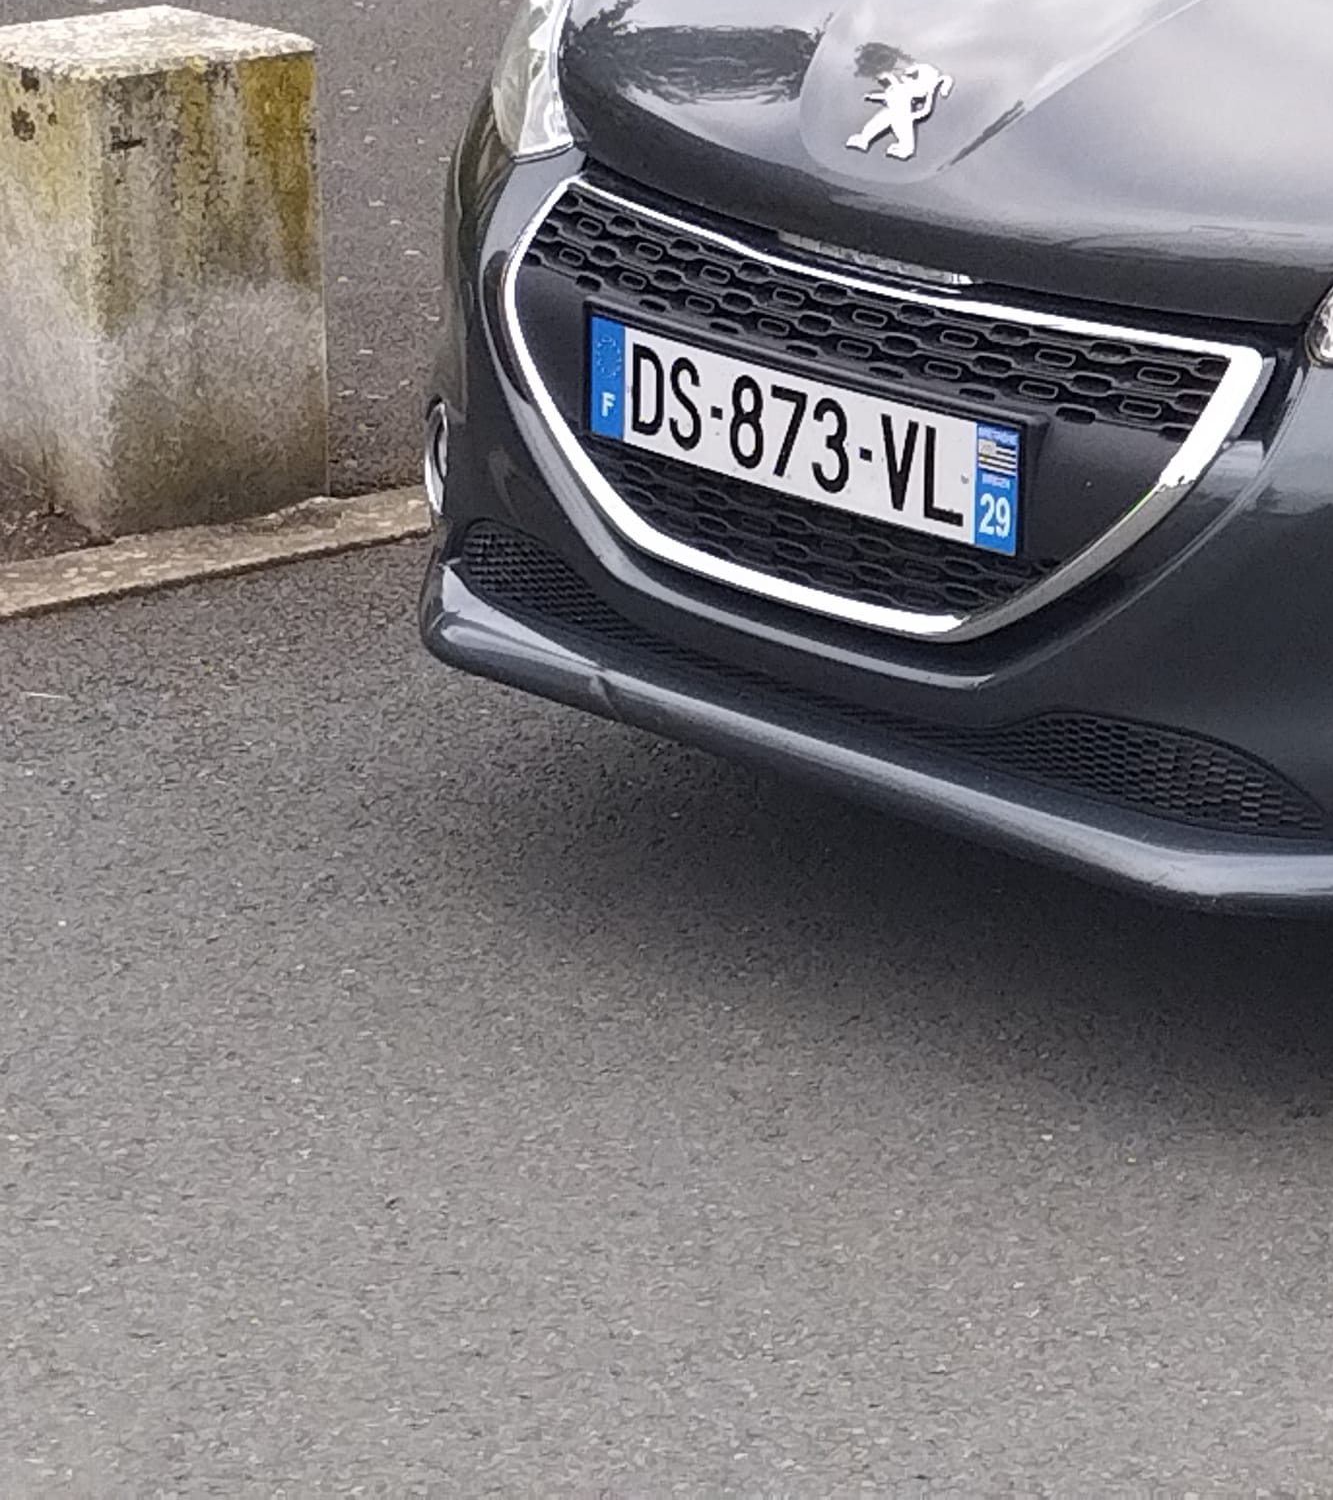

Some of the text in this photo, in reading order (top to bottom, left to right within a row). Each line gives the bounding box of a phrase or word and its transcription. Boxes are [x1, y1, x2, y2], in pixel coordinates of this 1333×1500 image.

[601, 391, 615, 417] F
[632, 343, 964, 527] DS-873-VL
[979, 493, 1011, 538] 29
